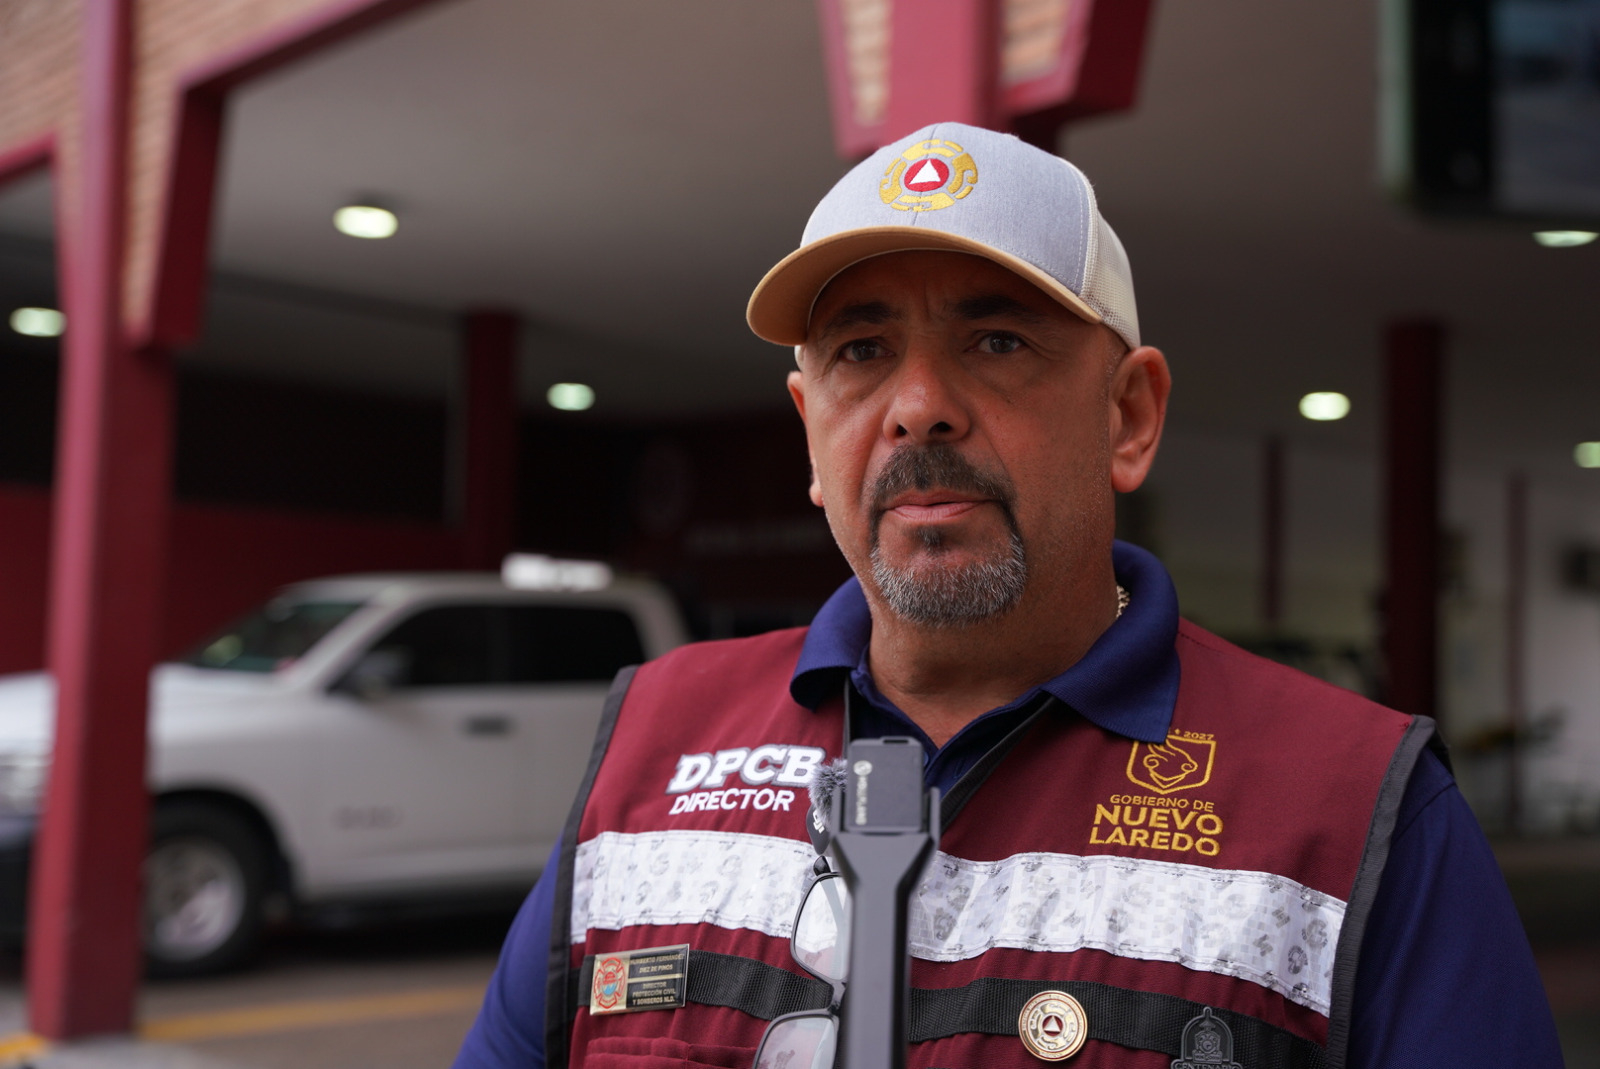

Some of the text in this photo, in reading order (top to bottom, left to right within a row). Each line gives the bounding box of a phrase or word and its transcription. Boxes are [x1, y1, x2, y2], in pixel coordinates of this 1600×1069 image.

[1183, 730, 1214, 740] 2027
[666, 744, 826, 794] DPCB
[668, 788, 795, 815] DIRECTOR
[1110, 794, 1215, 813] GOBIERNO DE
[1093, 803, 1224, 835] NUEVO
[1089, 826, 1220, 856] LAREDO
